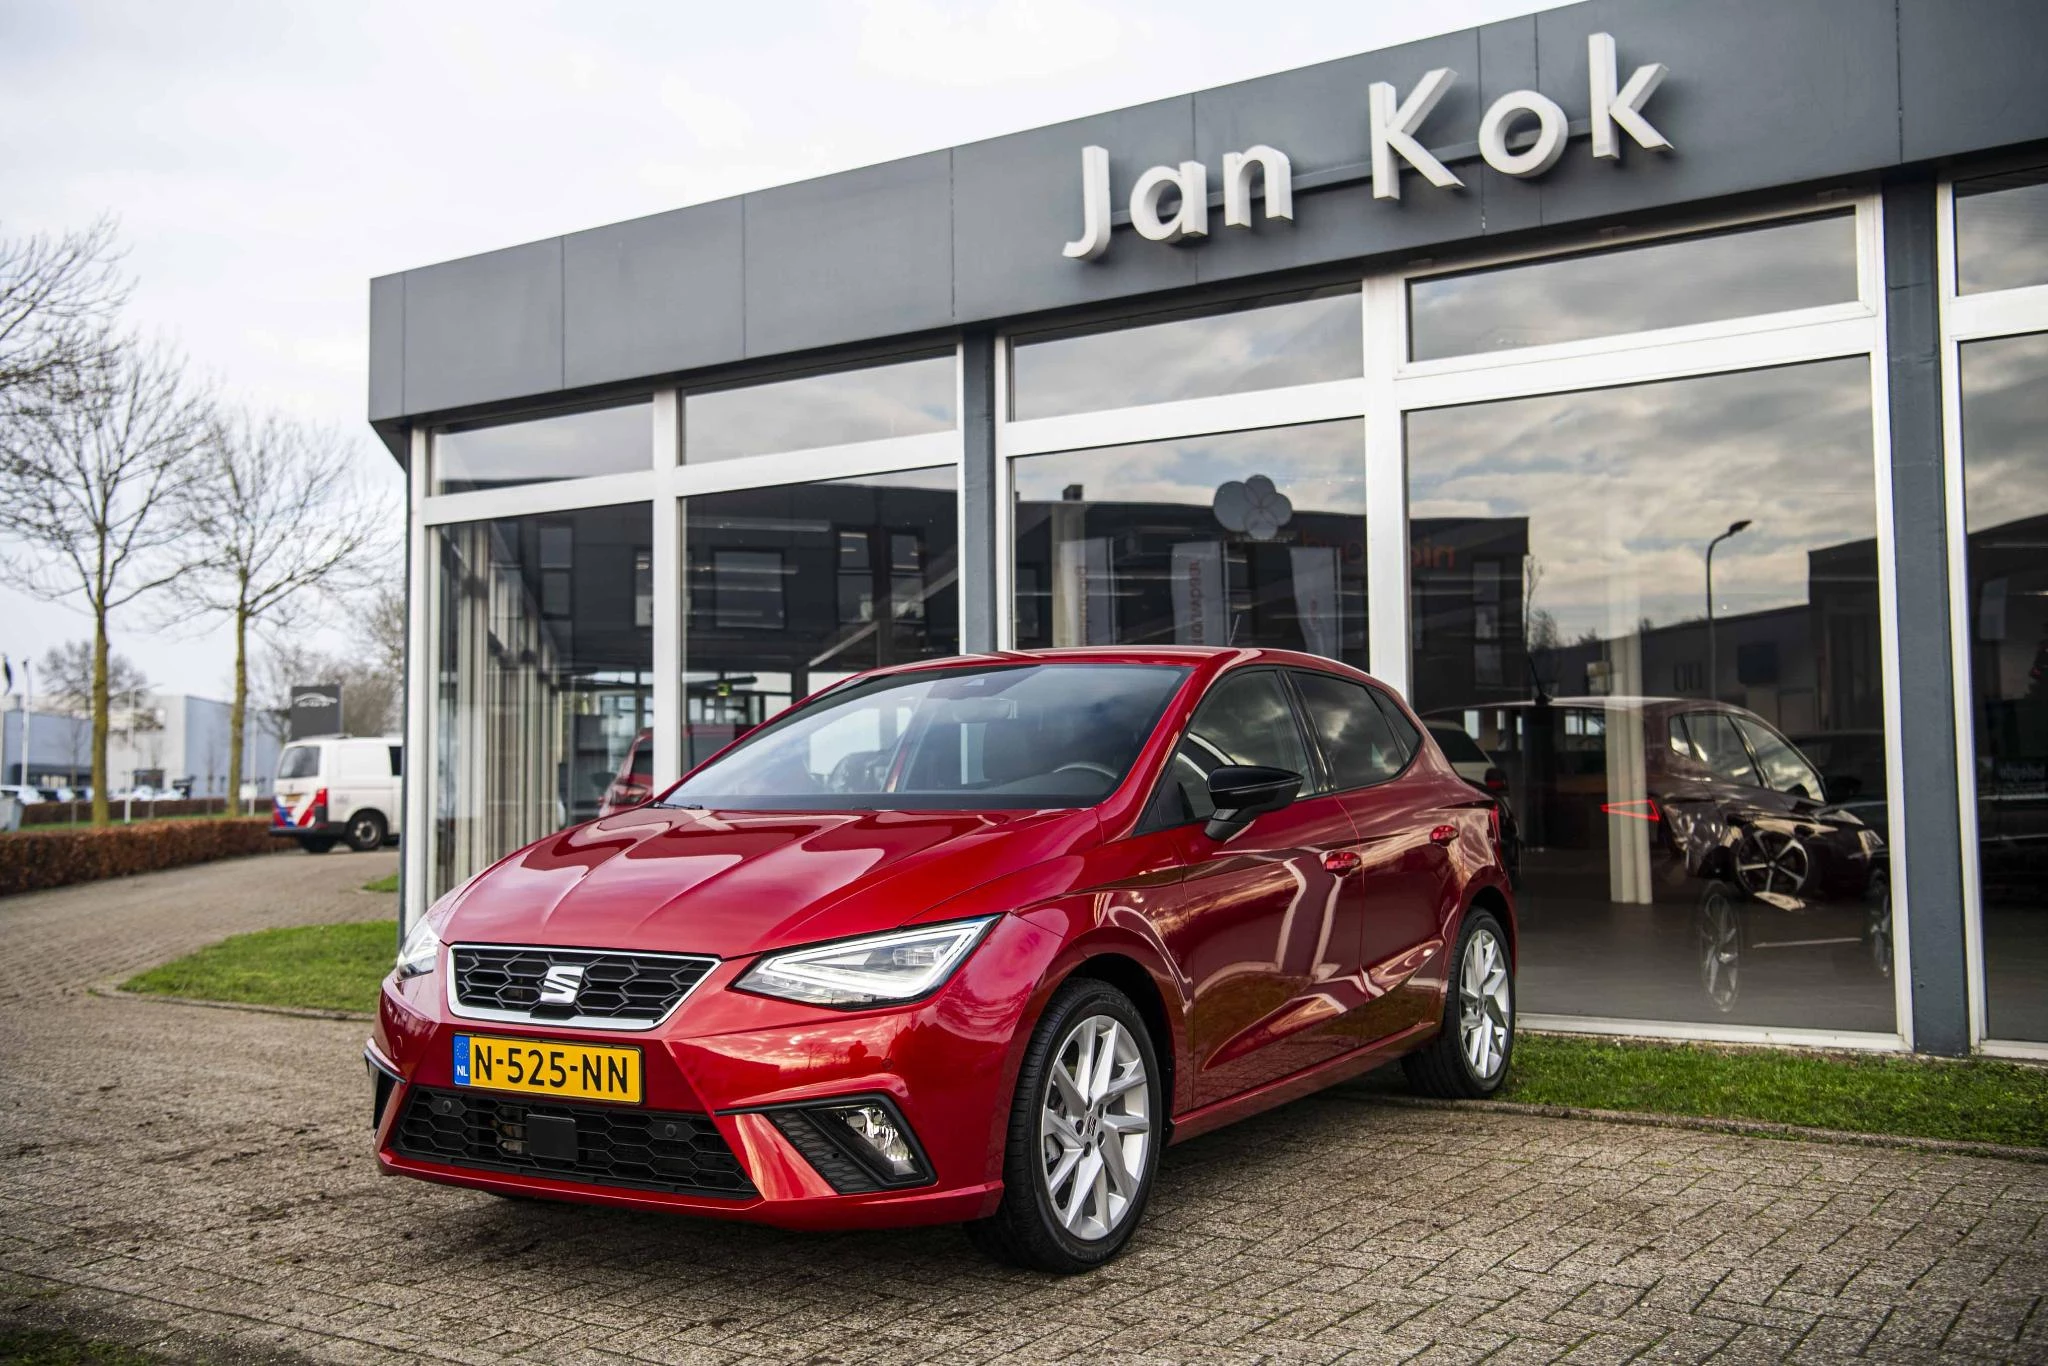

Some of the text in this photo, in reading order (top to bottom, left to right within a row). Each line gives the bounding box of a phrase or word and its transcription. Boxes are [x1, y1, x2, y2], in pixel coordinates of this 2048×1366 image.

[1063, 32, 1674, 258] Jan Kok
[456, 1045, 627, 1093] NL N-525-NN
